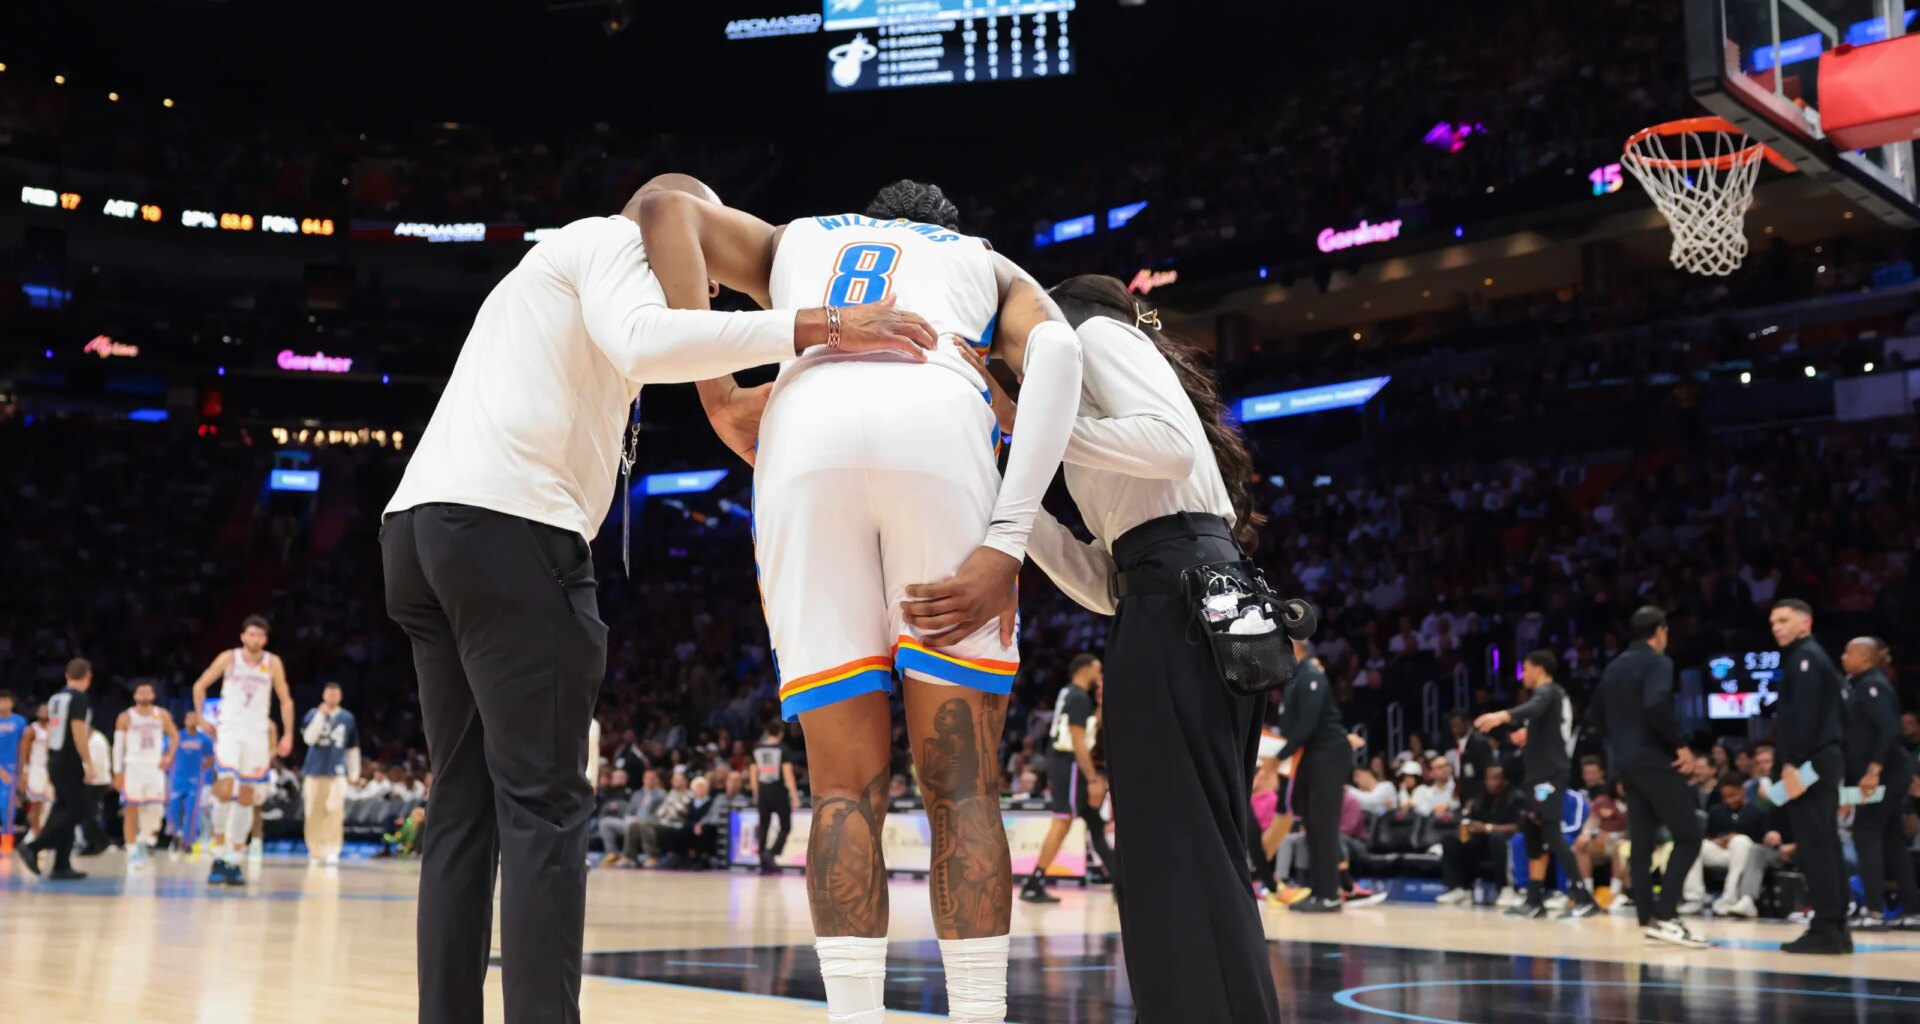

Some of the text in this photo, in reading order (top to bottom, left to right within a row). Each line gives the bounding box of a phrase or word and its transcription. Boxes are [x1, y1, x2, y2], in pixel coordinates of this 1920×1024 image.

[1589, 163, 1623, 196] 15
[60, 193, 81, 210] 17
[103, 199, 162, 222] AST 10
[1318, 219, 1402, 253] Gardner
[823, 241, 902, 308] 8
[277, 349, 353, 372] Gardner
[1744, 651, 1781, 670] 5:39
